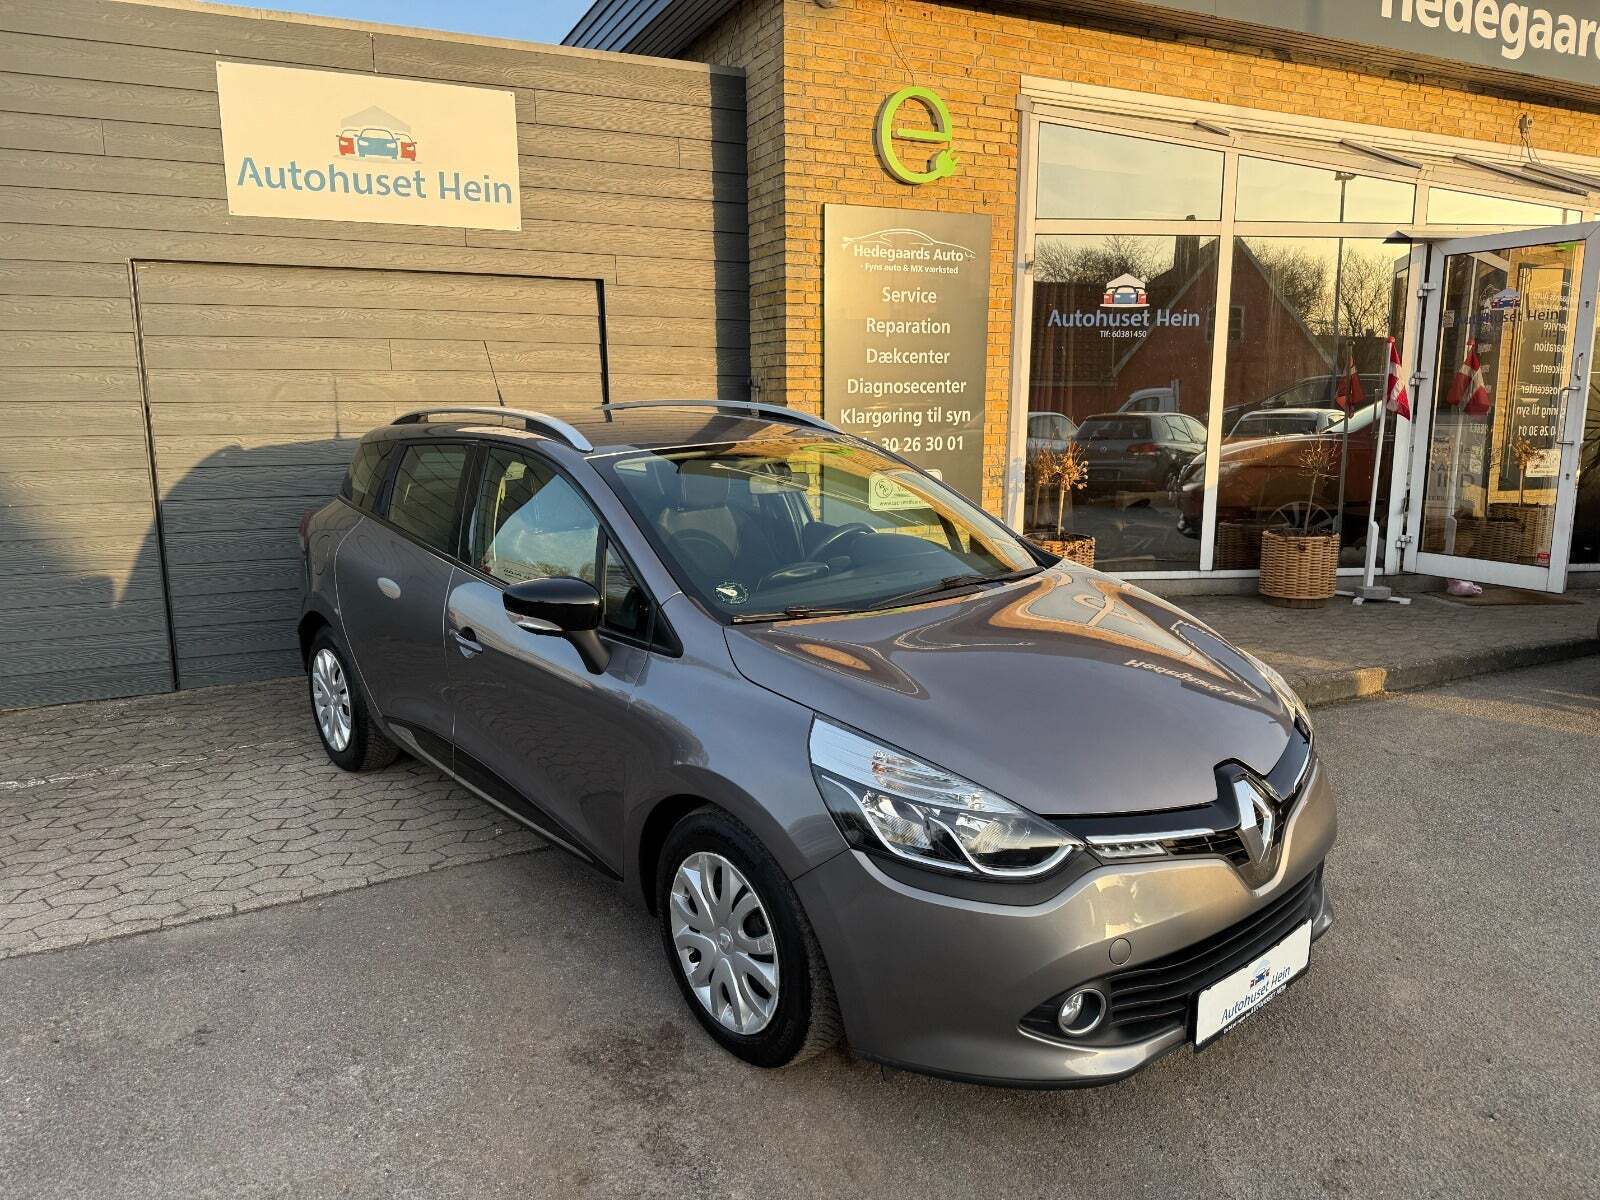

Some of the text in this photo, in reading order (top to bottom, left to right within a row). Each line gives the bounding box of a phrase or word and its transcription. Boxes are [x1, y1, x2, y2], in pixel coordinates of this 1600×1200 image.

[237, 156, 513, 204] Autohuset Hein
[853, 244, 964, 262] Hedegaards Auto
[865, 263, 959, 274] Fyns auto & MX værksted
[882, 286, 937, 304] Service
[1048, 308, 1200, 328] Autohuset Hein
[1527, 309, 1559, 321] Hein
[866, 317, 951, 337] Reparation
[1100, 330, 1147, 338] Tlf: 60381450
[866, 348, 951, 364] Dækcenter
[847, 378, 967, 395] Diagnosecenter
[840, 407, 971, 427] Klargøring til syn
[903, 437, 921, 452] 26
[925, 436, 943, 451] 30
[947, 436, 963, 450] 01
[1221, 980, 1269, 1024] Autohuset
[1271, 966, 1291, 988] Hein
